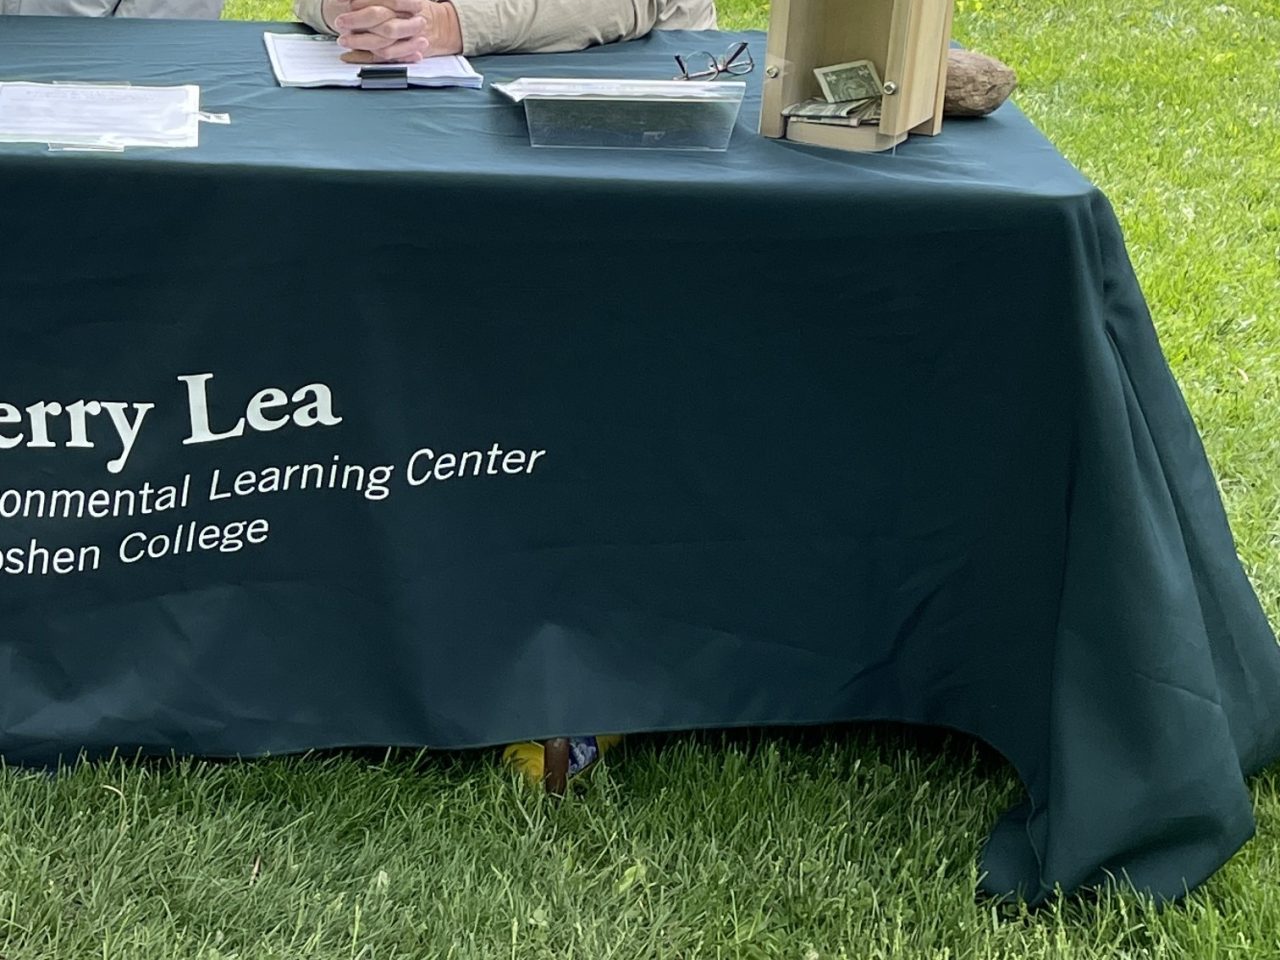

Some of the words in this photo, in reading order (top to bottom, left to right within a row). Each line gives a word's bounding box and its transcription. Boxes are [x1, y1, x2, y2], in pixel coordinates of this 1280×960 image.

[177, 372, 343, 445] Lea
[209, 454, 395, 501] Learning
[406, 442, 546, 486] Center
[119, 518, 269, 563] College
